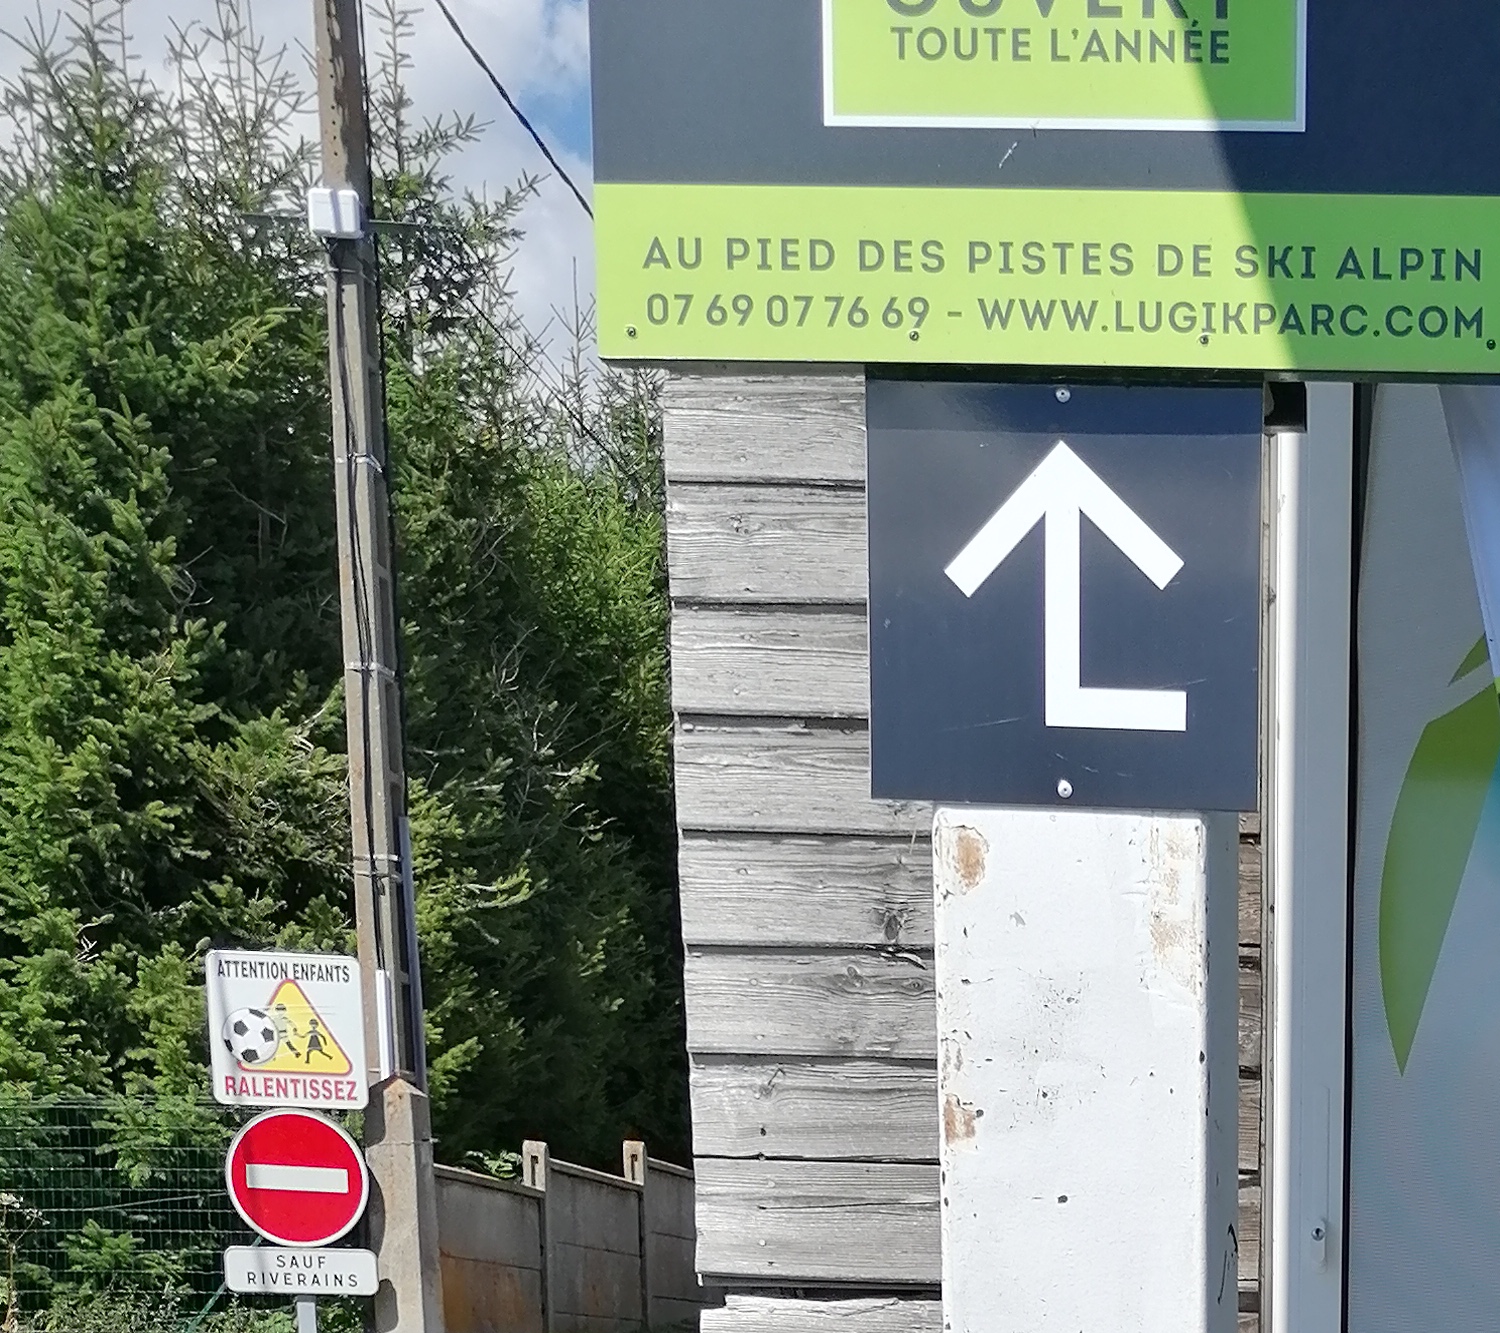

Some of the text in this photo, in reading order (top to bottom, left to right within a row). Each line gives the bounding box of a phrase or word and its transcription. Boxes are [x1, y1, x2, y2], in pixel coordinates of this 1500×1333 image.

[890, 19, 1230, 64] TOUTE L'ANNÉE
[642, 236, 1481, 282] AU PIED DES PISTES DE SKI ALPIN
[647, 294, 694, 326] 07
[706, 294, 754, 327] 69
[881, 297, 930, 329] 69
[977, 298, 1484, 339] WWW.LUGIKPARC.COM
[217, 959, 350, 984] ATTENTION ENFANTS
[225, 1075, 357, 1101] RALENTISSEZ
[276, 1255, 326, 1269] SAUF
[247, 1272, 358, 1287] RIVERAINS
